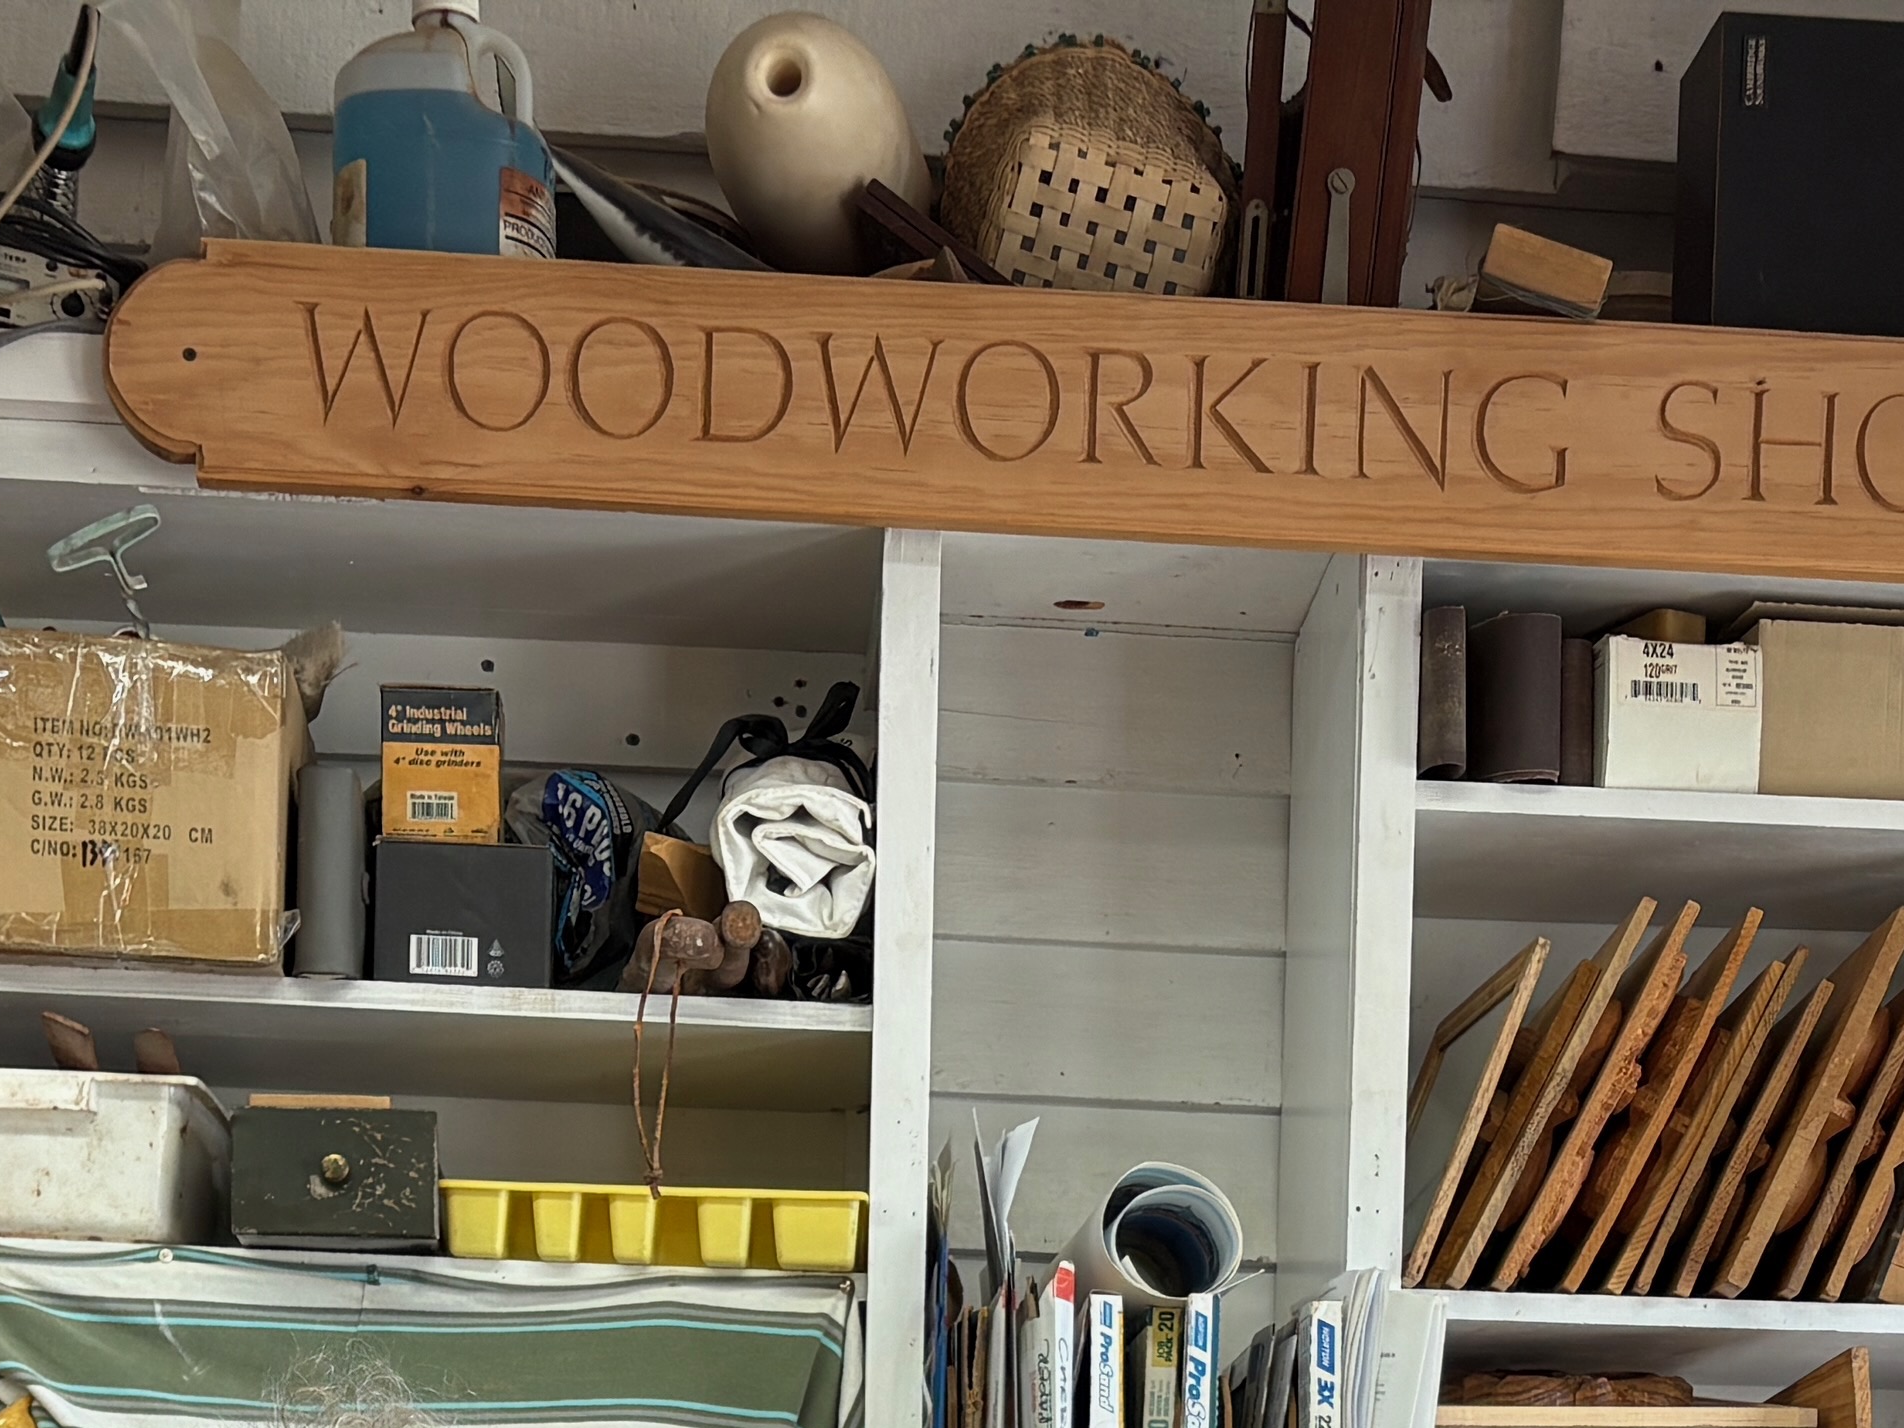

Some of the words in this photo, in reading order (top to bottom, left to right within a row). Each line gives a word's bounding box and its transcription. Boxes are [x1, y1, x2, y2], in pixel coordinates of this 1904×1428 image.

[299, 298, 1573, 496] WOODWORKING
[1642, 642, 1674, 659] 4X24
[1644, 663, 1660, 679] 120
[405, 706, 467, 721] Industrial
[33, 717, 74, 735] ITEM
[388, 720, 441, 737] Grinding
[445, 722, 492, 736] Wheels
[32, 742, 71, 759] QTY:
[78, 745, 95, 761] 12
[415, 748, 436, 757] Use
[440, 749, 465, 758] with
[408, 757, 432, 767] disc
[435, 758, 482, 769] grinders
[114, 772, 148, 790] KGS
[80, 794, 104, 810] 2.8
[114, 796, 148, 813] KGS
[31, 815, 74, 832] SIZE:
[88, 819, 171, 840] 38X20X20
[188, 827, 213, 844] CM
[1159, 1310, 1175, 1332] 20
[1319, 1325, 1332, 1368] NORTON
[1098, 1331, 1114, 1413] ProSand
[1317, 1376, 1335, 1409] 3X
